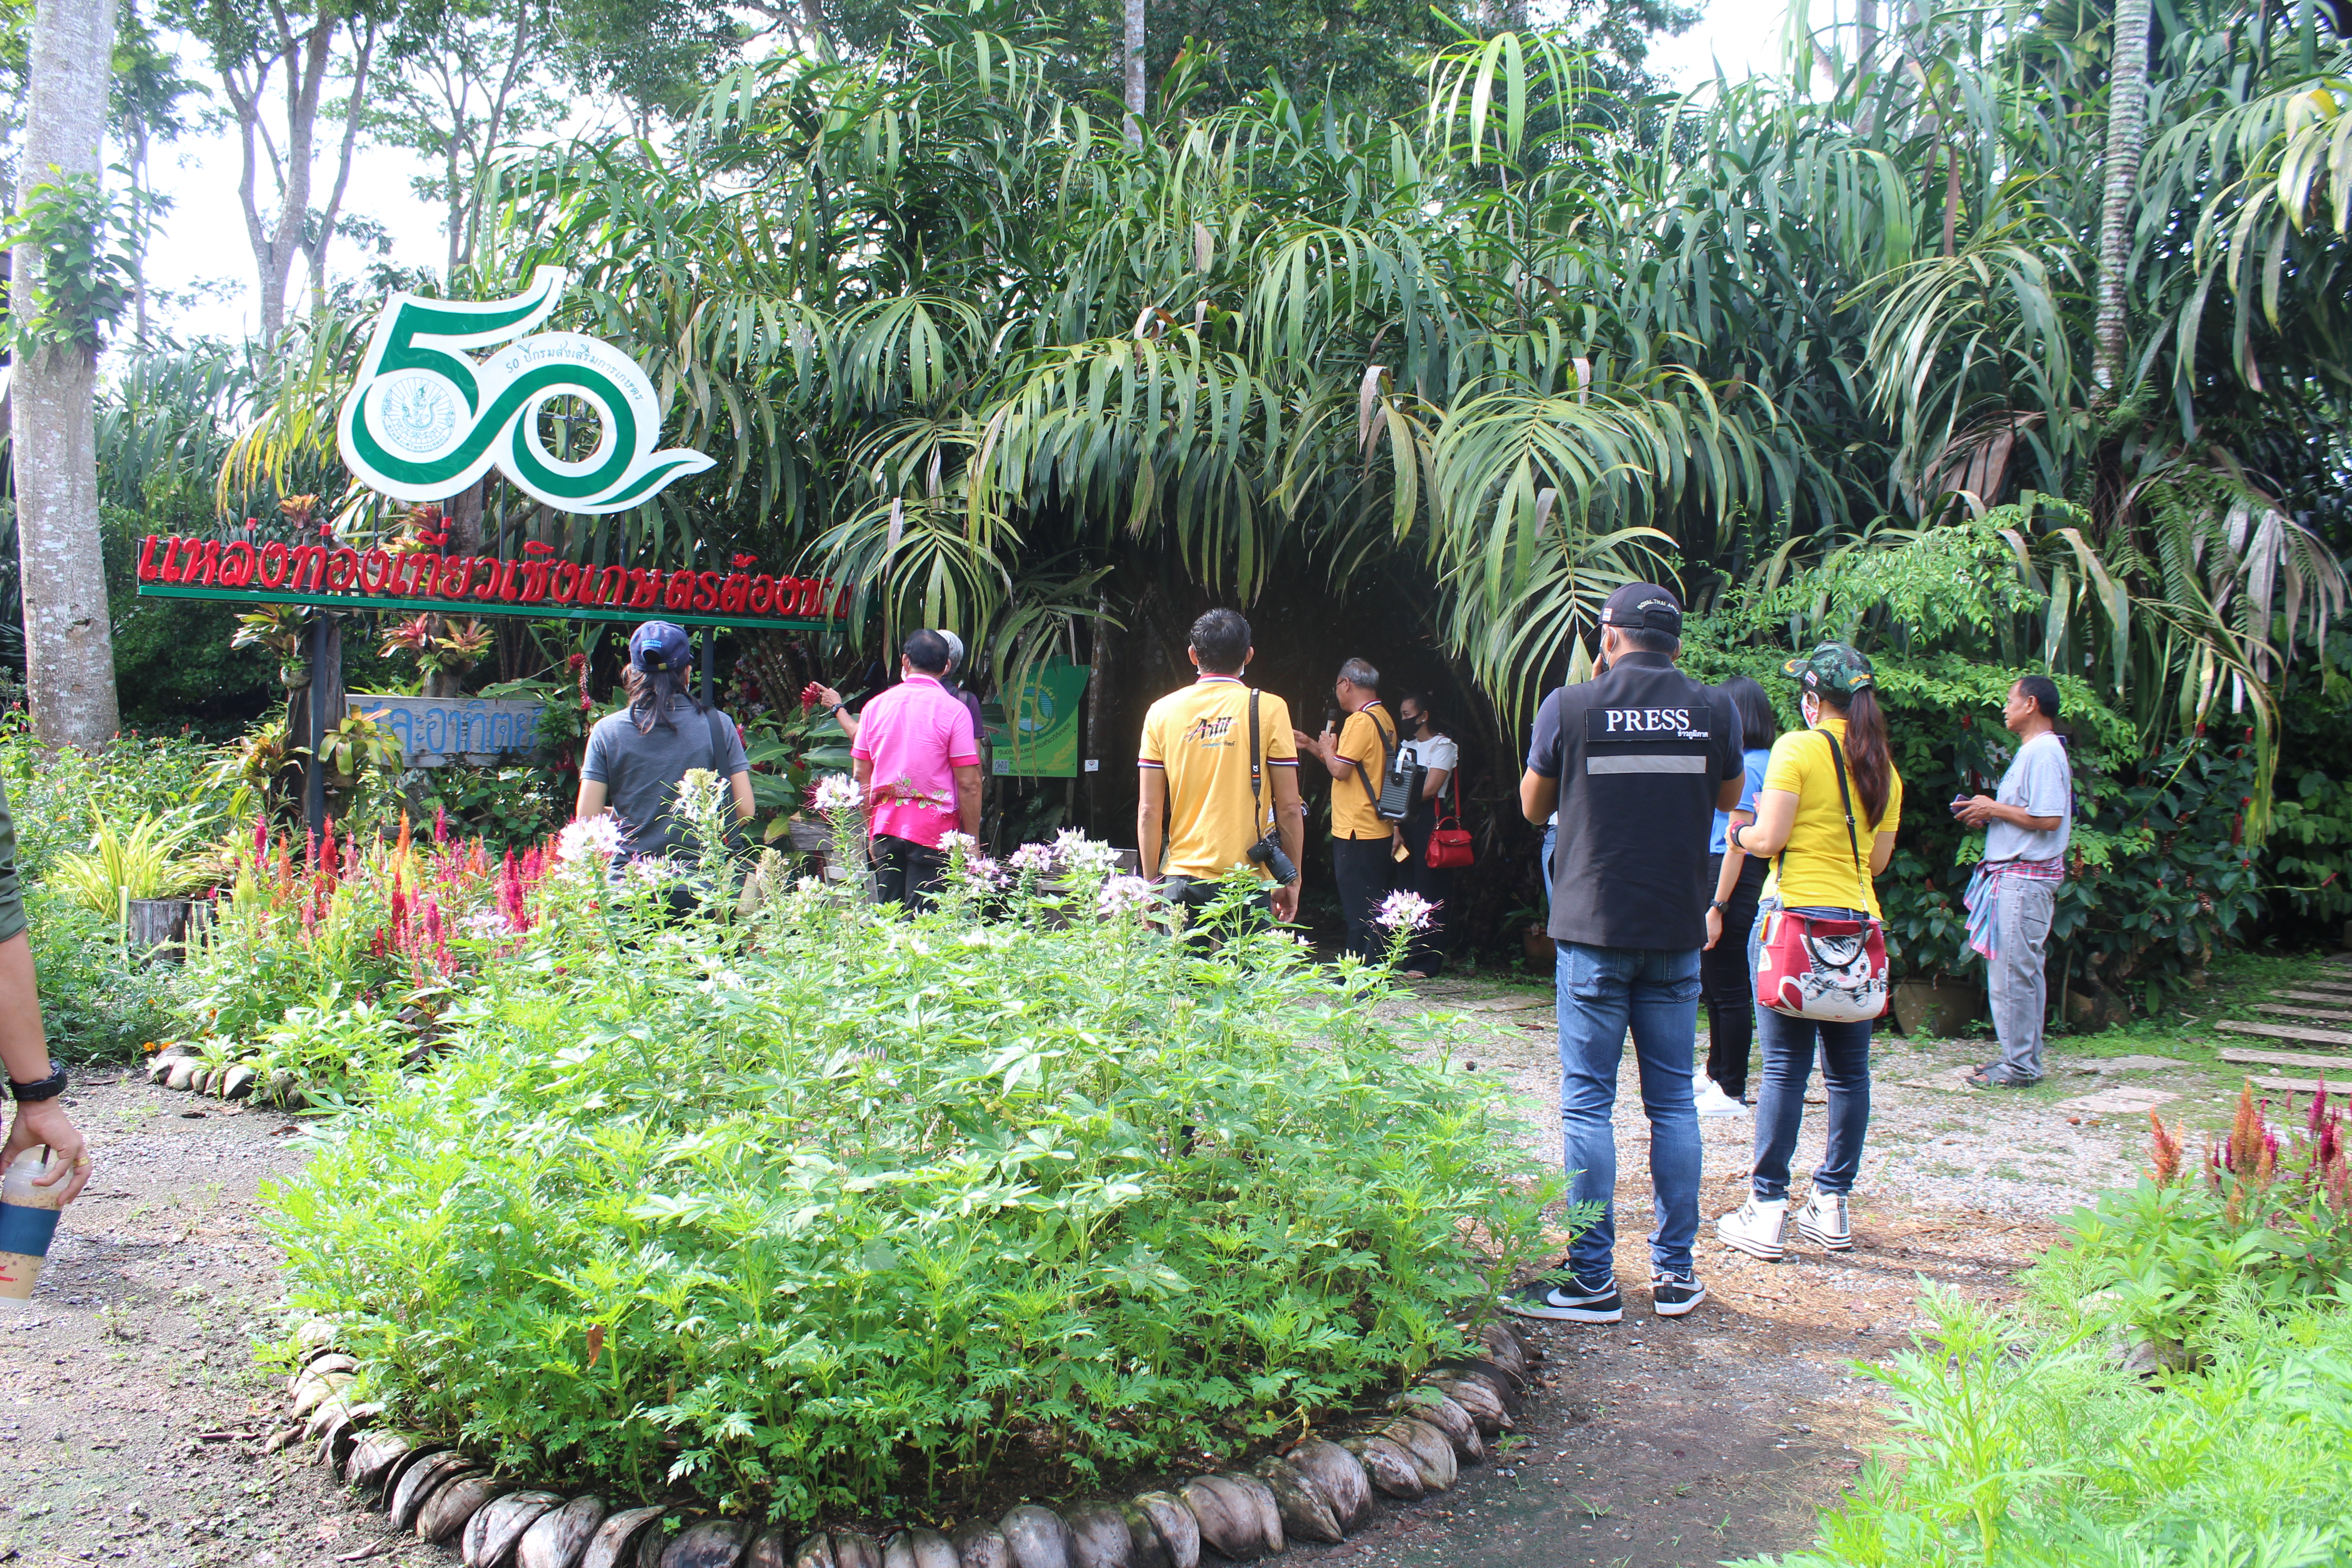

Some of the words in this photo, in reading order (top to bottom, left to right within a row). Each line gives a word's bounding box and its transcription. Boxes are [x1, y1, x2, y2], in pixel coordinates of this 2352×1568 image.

[505, 358, 519, 373] 50
[517, 340, 644, 401] ปีกรมส่งเสริมการเกษตร
[1637, 599, 1654, 610] ROYAL
[1606, 709, 1690, 732] PRESS
